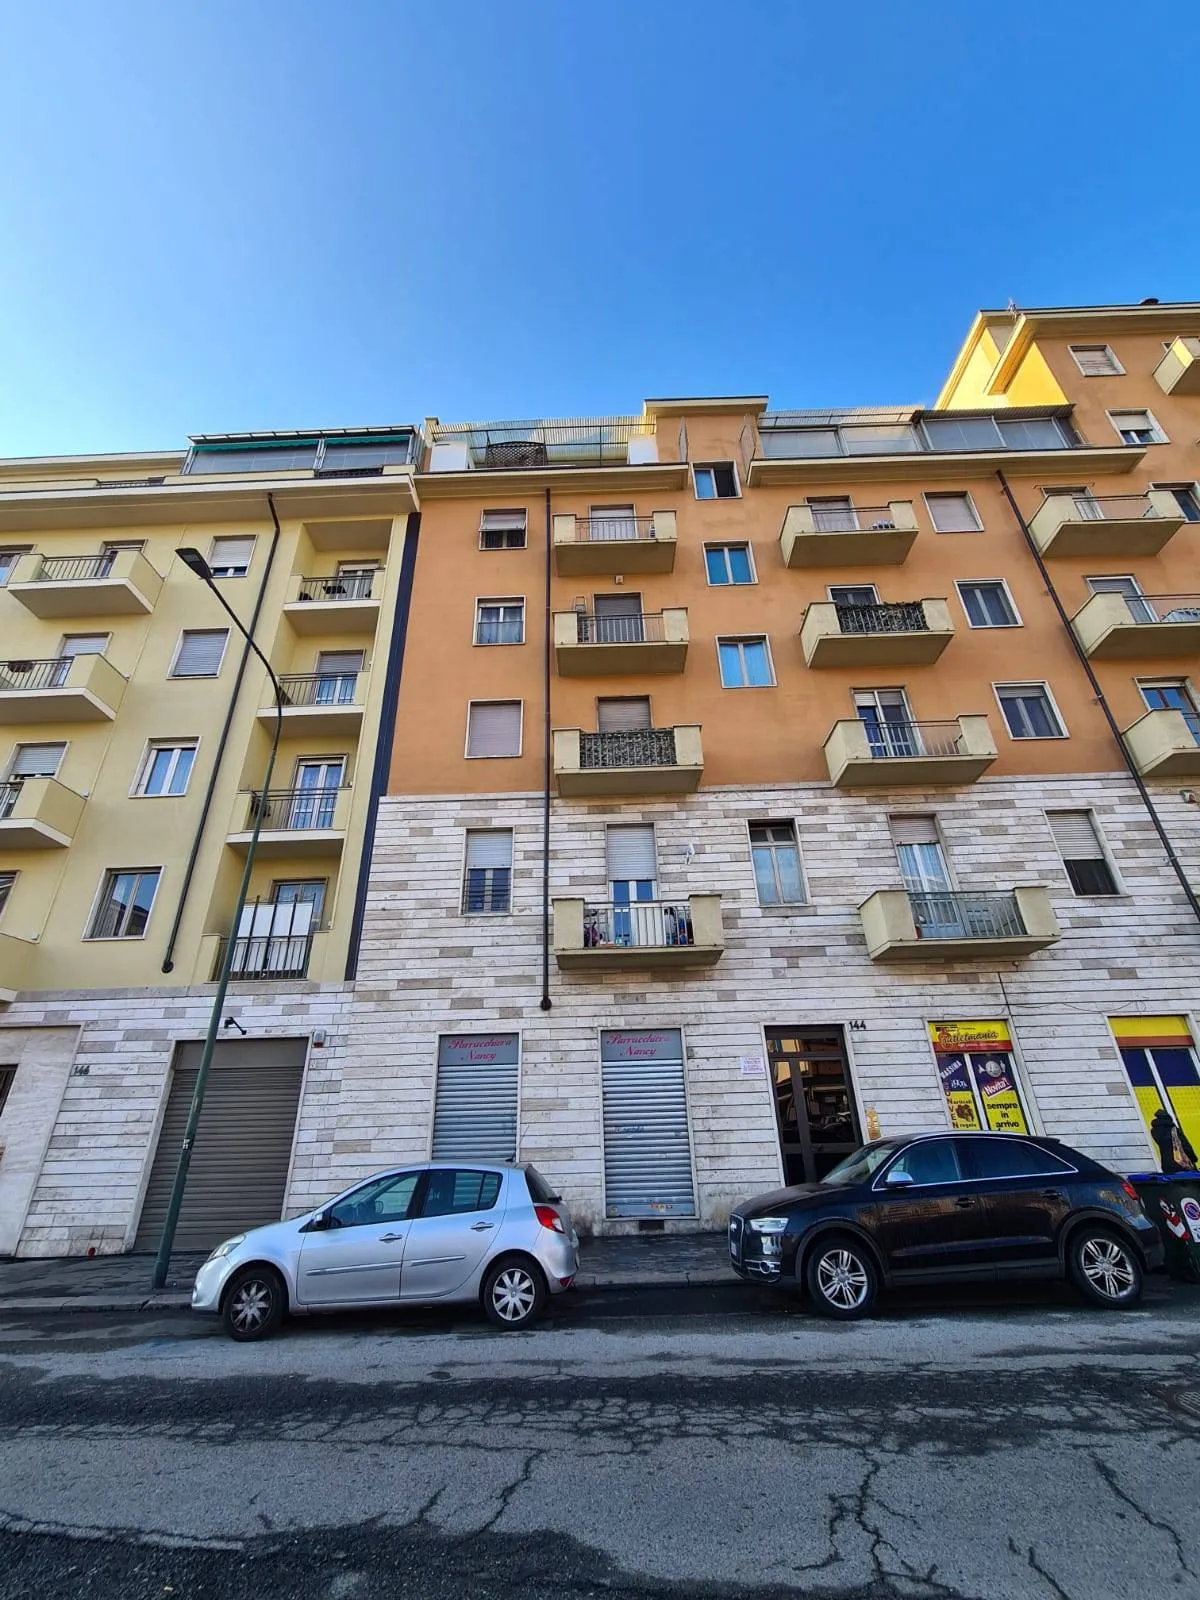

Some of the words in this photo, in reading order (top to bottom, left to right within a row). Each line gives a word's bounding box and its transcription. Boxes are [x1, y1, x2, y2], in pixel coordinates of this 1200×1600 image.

[849, 1020, 866, 1030] 144
[461, 1050, 497, 1062] Nancy
[620, 1046, 657, 1057] Nancy
[940, 1060, 962, 1079] MASSIMA
[1000, 1110, 1009, 1118] in
[996, 1120, 1020, 1128] arrivo
